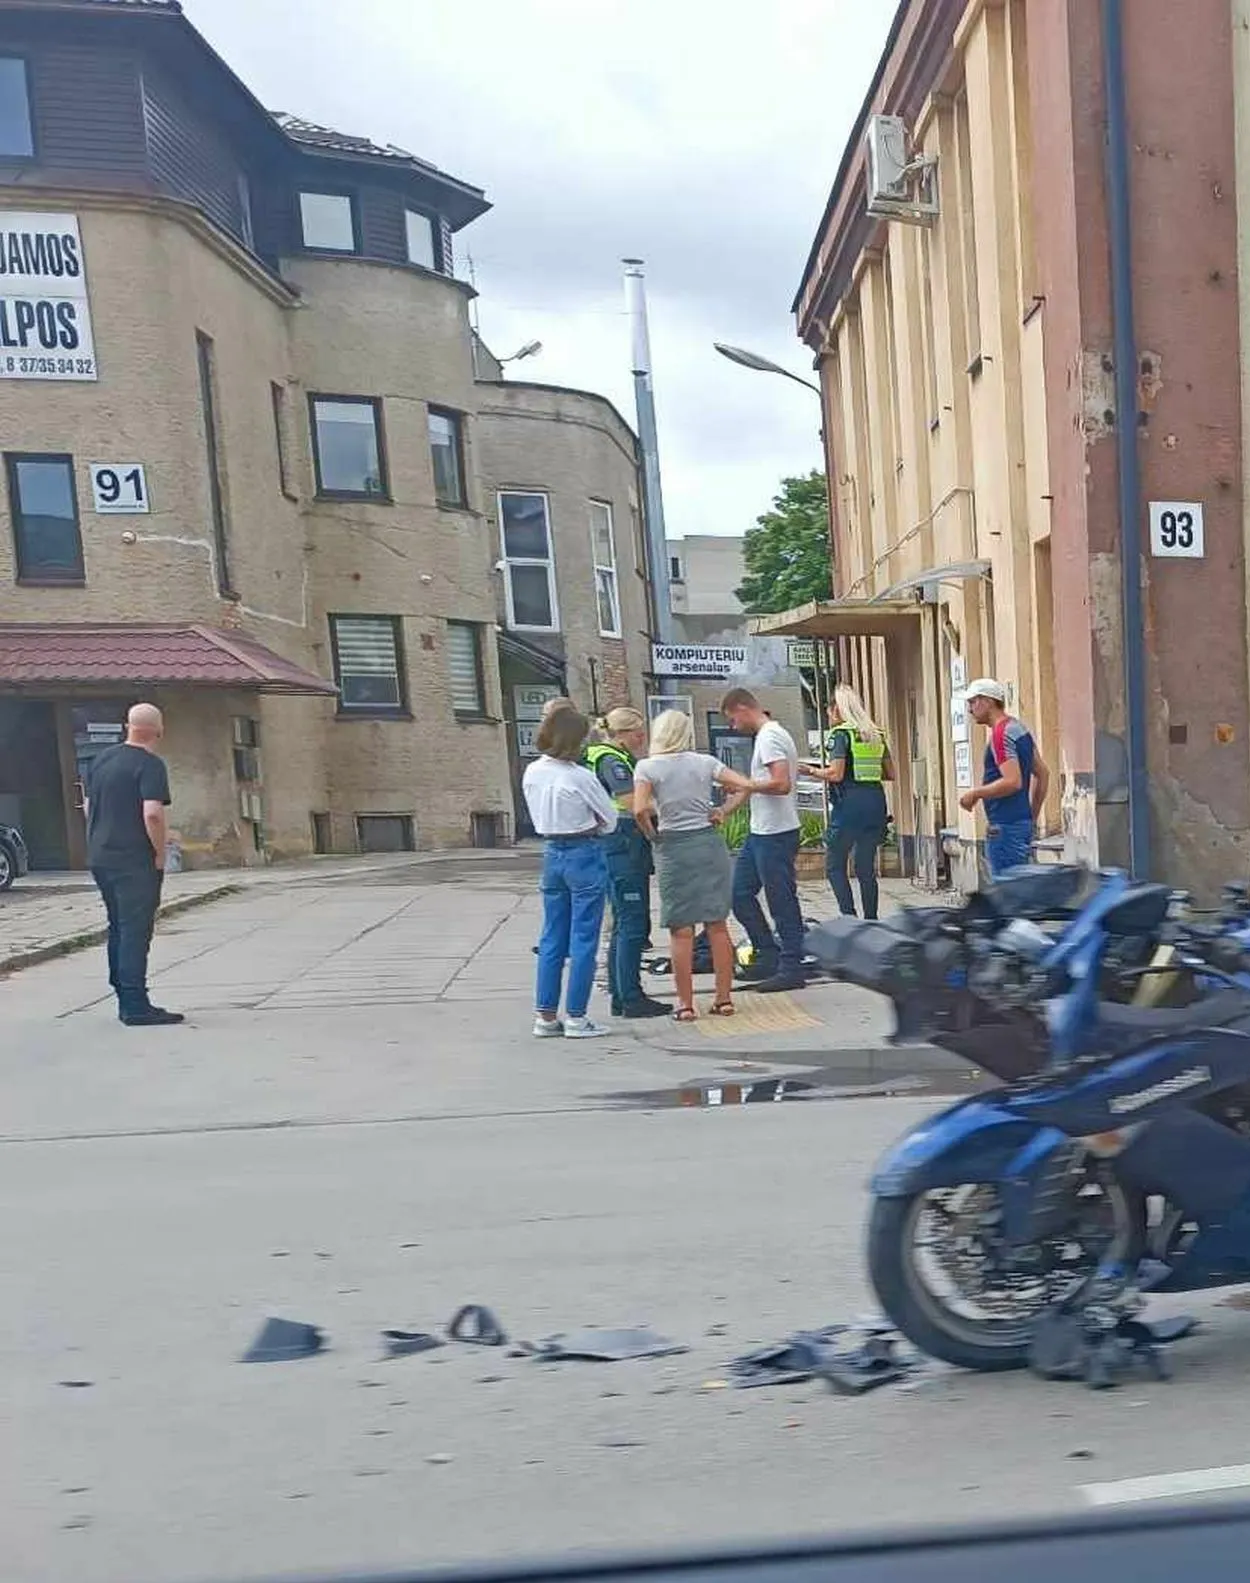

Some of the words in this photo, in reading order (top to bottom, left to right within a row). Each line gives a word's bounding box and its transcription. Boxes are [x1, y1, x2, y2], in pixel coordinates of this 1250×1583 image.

[0, 300, 79, 350] LPOS
[95, 469, 143, 502] 91
[1160, 510, 1194, 548] 93
[671, 662, 731, 673] arsenalas
